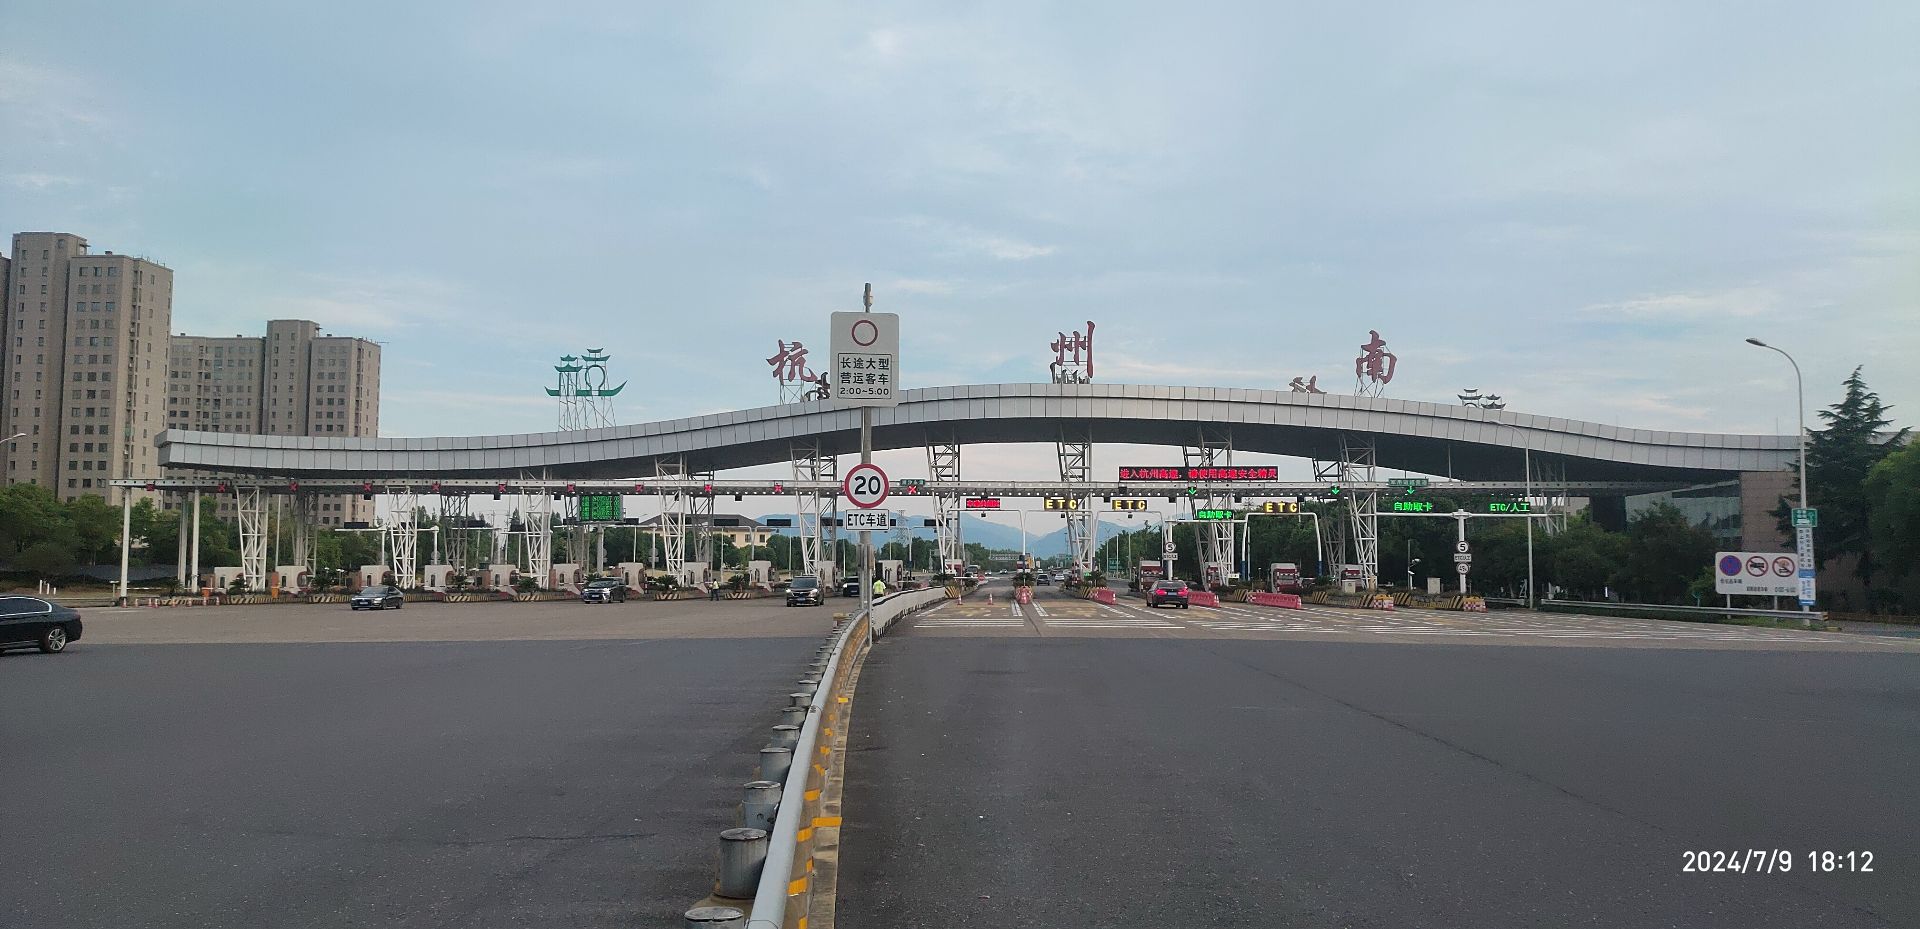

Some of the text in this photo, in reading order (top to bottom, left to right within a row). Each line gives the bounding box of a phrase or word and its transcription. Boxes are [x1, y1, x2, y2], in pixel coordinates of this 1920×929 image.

[766, 321, 1398, 385] 杭 州 南
[840, 357, 890, 370] 长途大型
[840, 372, 889, 385] 营运客车
[840, 387, 889, 396] 2:00~5:00
[854, 475, 881, 495] 20
[1046, 500, 1077, 509] ETC
[1115, 500, 1146, 509] ETC
[1266, 503, 1298, 513] ETC
[1394, 502, 1432, 512] 自助取卡
[1490, 503, 1530, 512] ETC/人工
[1198, 510, 1233, 519] 自助取卡
[847, 513, 888, 527] ETC车道
